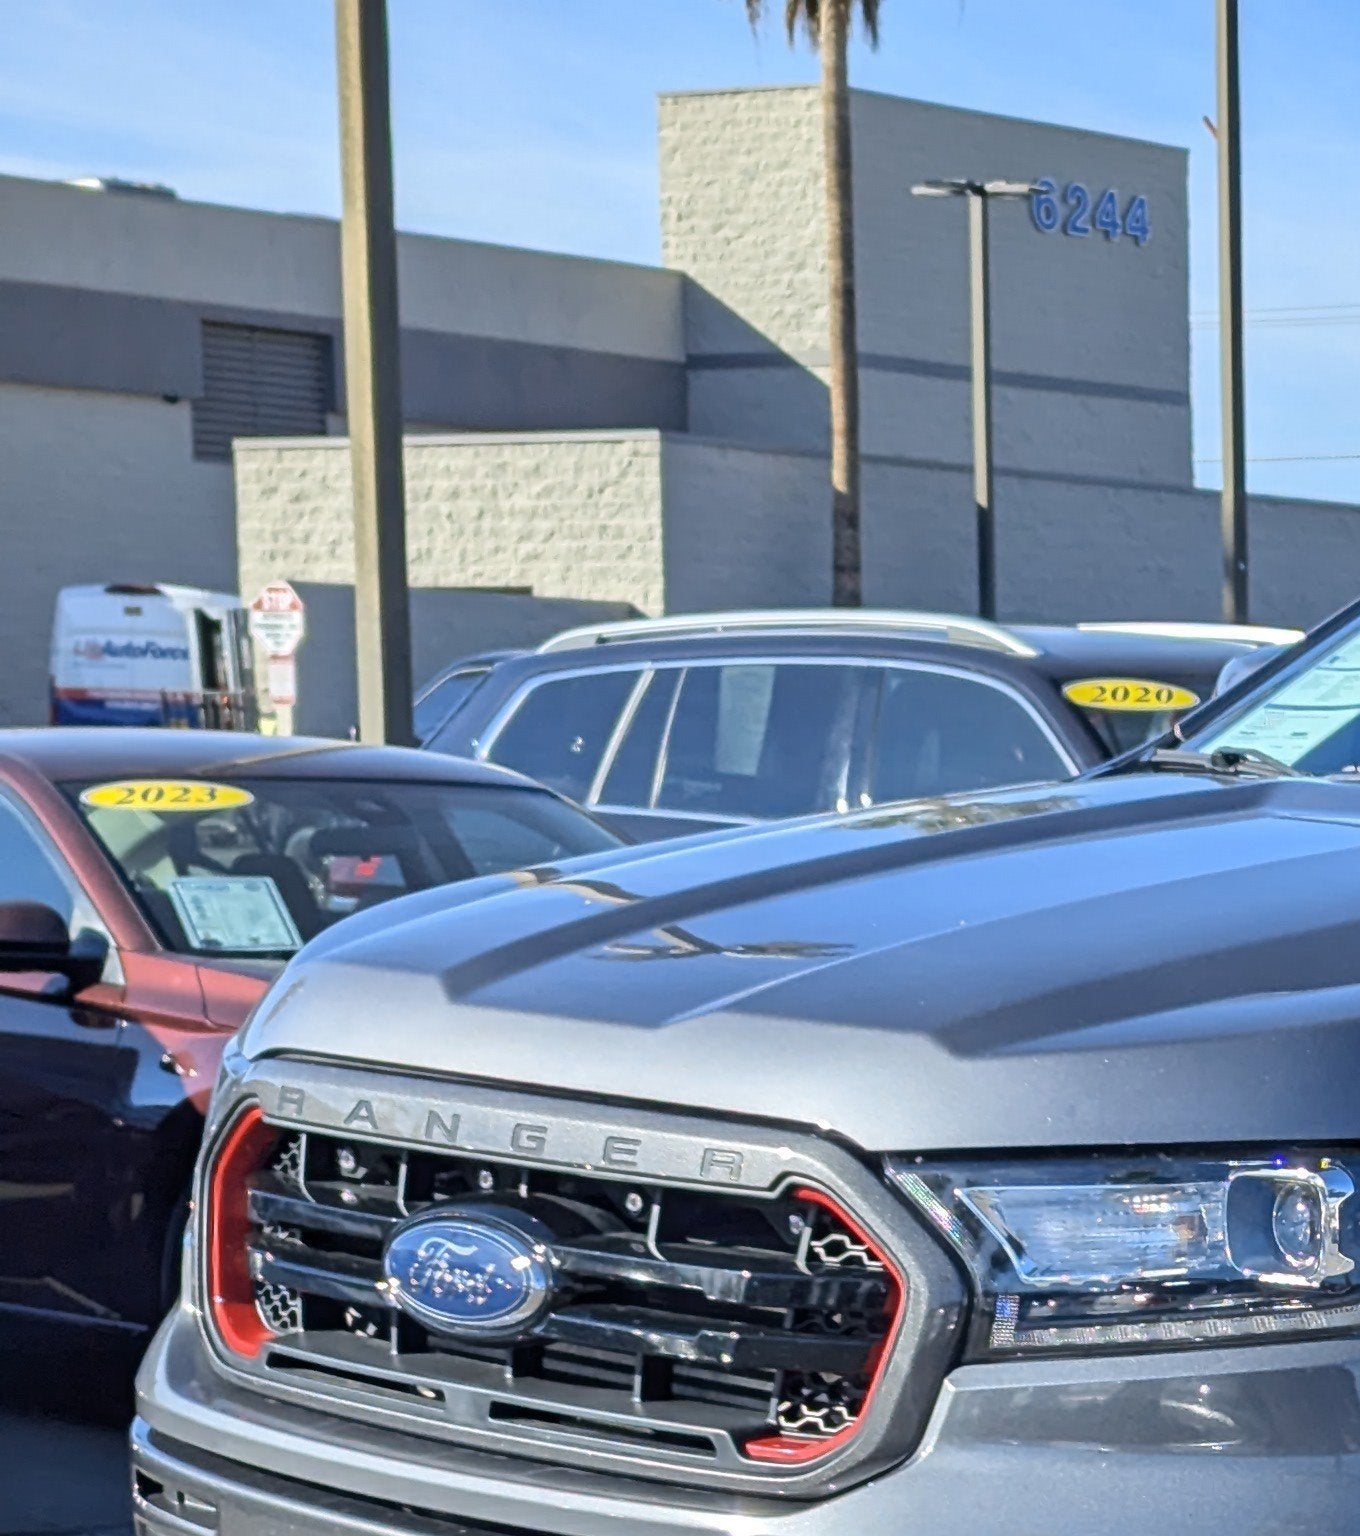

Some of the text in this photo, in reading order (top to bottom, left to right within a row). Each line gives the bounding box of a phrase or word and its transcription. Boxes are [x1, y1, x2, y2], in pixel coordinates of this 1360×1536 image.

[1033, 177, 1151, 246] 6244
[1090, 685, 1174, 703] 2020
[115, 785, 218, 805] 2023
[276, 1084, 744, 1182] RANGER
[409, 1237, 514, 1304] Ford
